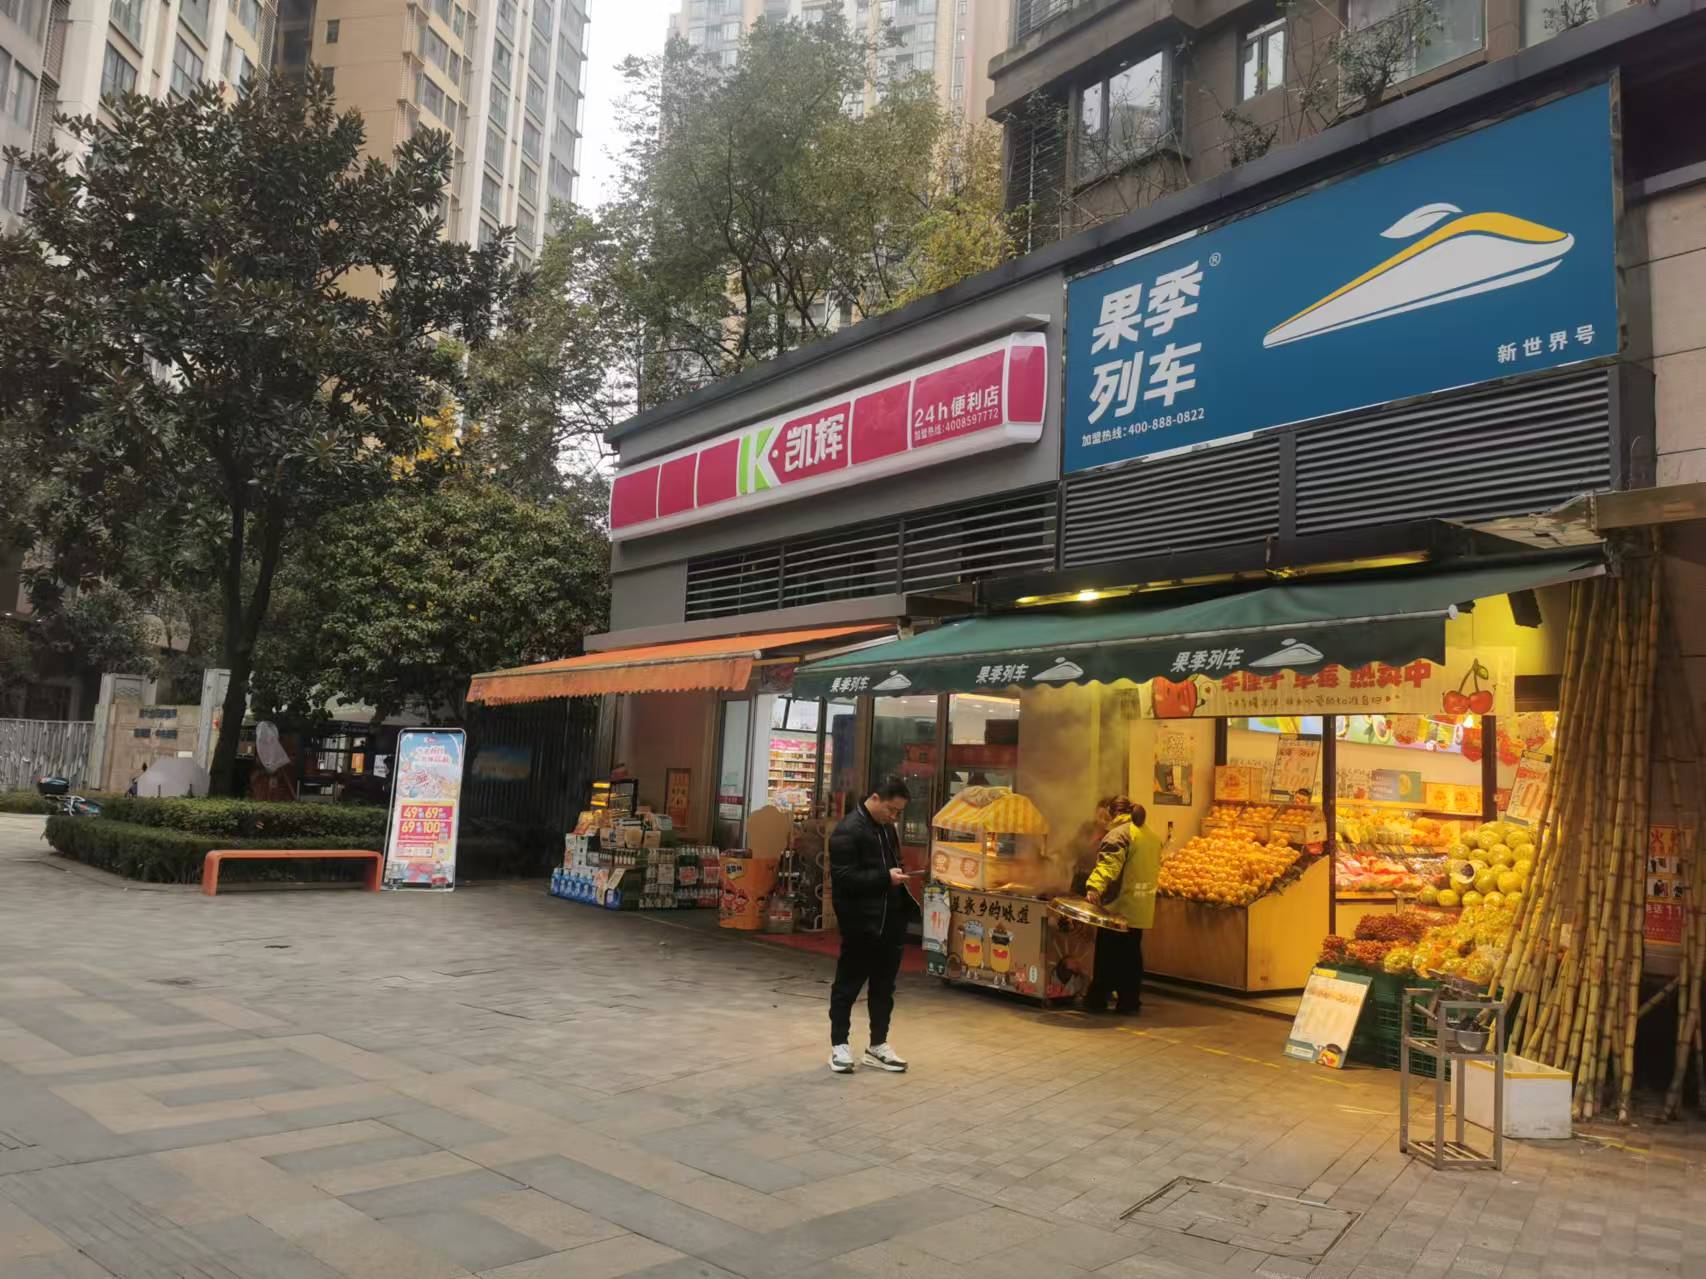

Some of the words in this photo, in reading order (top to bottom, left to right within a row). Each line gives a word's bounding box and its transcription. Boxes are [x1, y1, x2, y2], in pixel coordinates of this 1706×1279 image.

[1091, 261, 1203, 355] 果季
[1496, 323, 1596, 364] 新世界号
[1087, 343, 1202, 424] 列车
[914, 385, 1000, 428] 24h便利店
[784, 412, 844, 472] 凯辉
[976, 664, 1029, 684] 果季列车
[1171, 647, 1243, 673] 果季列车
[830, 676, 870, 693] 果季列车
